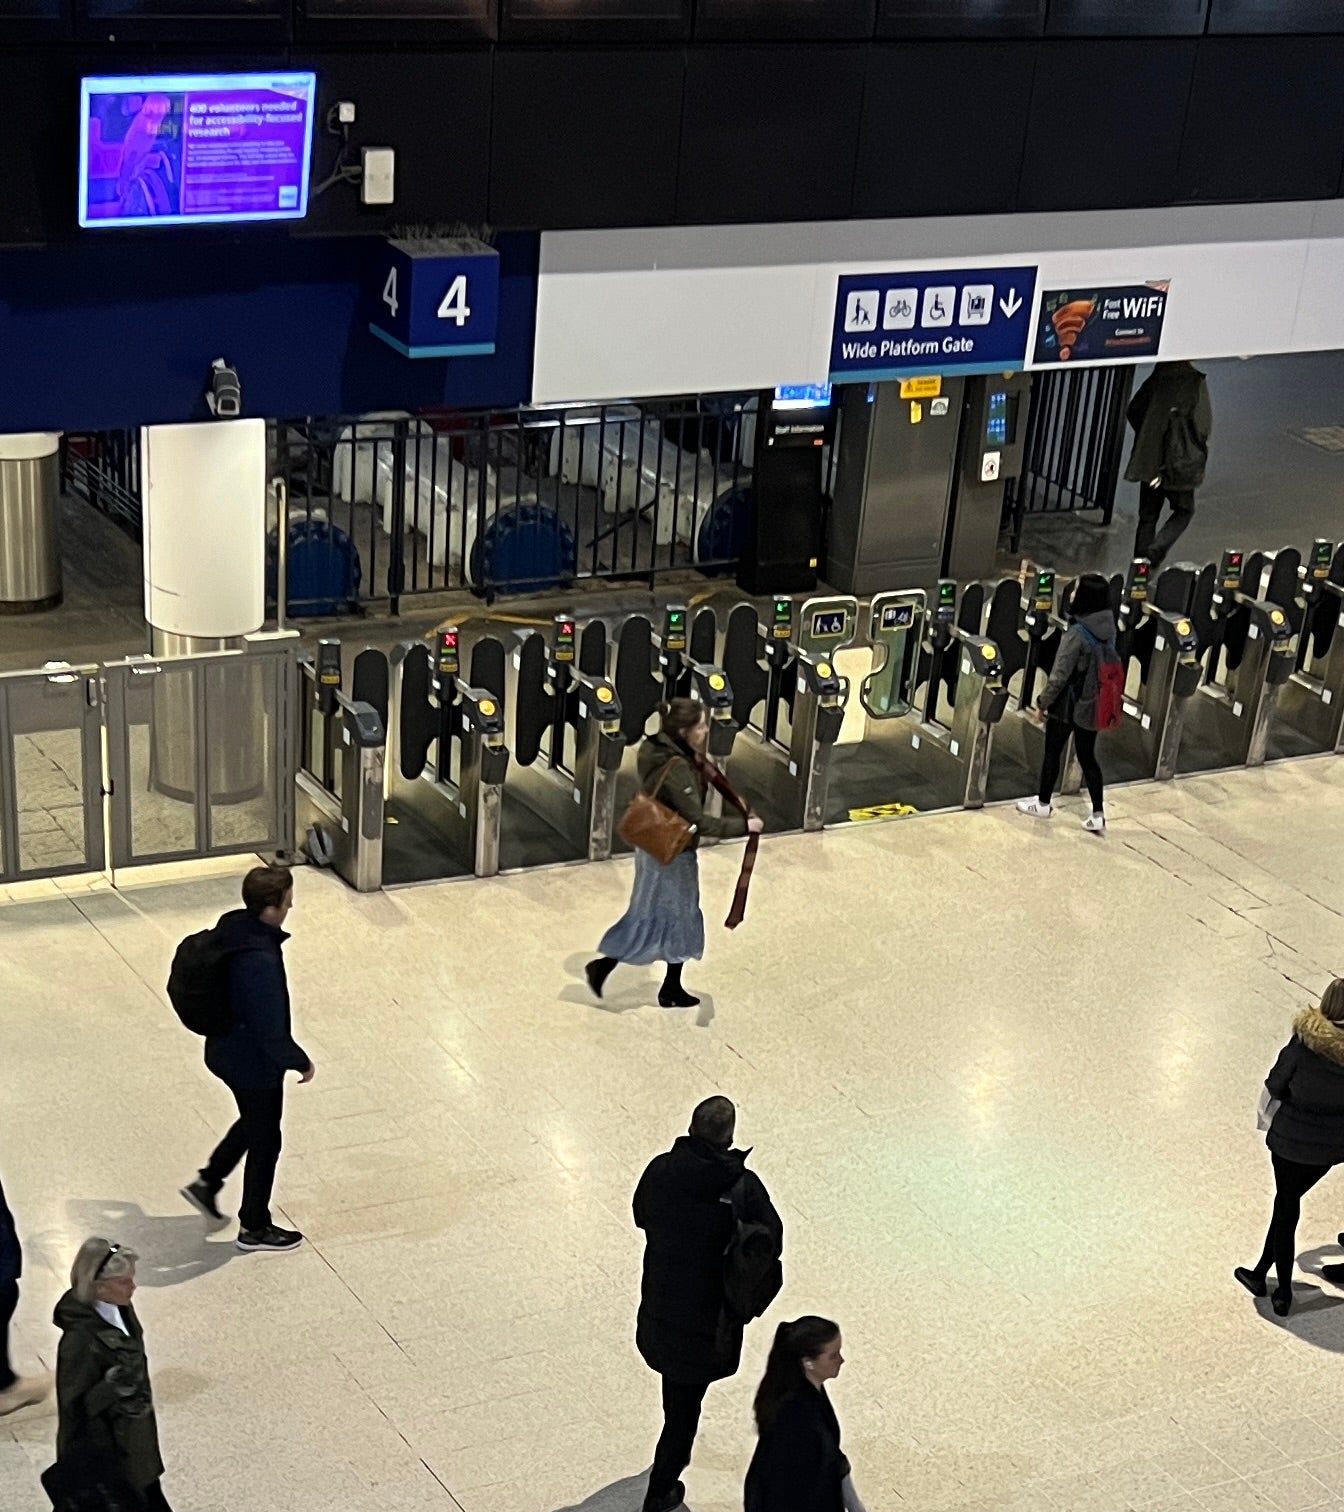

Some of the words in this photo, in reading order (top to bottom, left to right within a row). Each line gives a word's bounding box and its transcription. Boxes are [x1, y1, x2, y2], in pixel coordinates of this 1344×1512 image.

[382, 266, 399, 318] 4
[437, 274, 471, 327] 4
[1102, 309, 1120, 320] Free
[1123, 296, 1164, 319] WiFi
[842, 341, 877, 360] Wide
[879, 338, 939, 357] Platform
[942, 336, 974, 354] Gate
